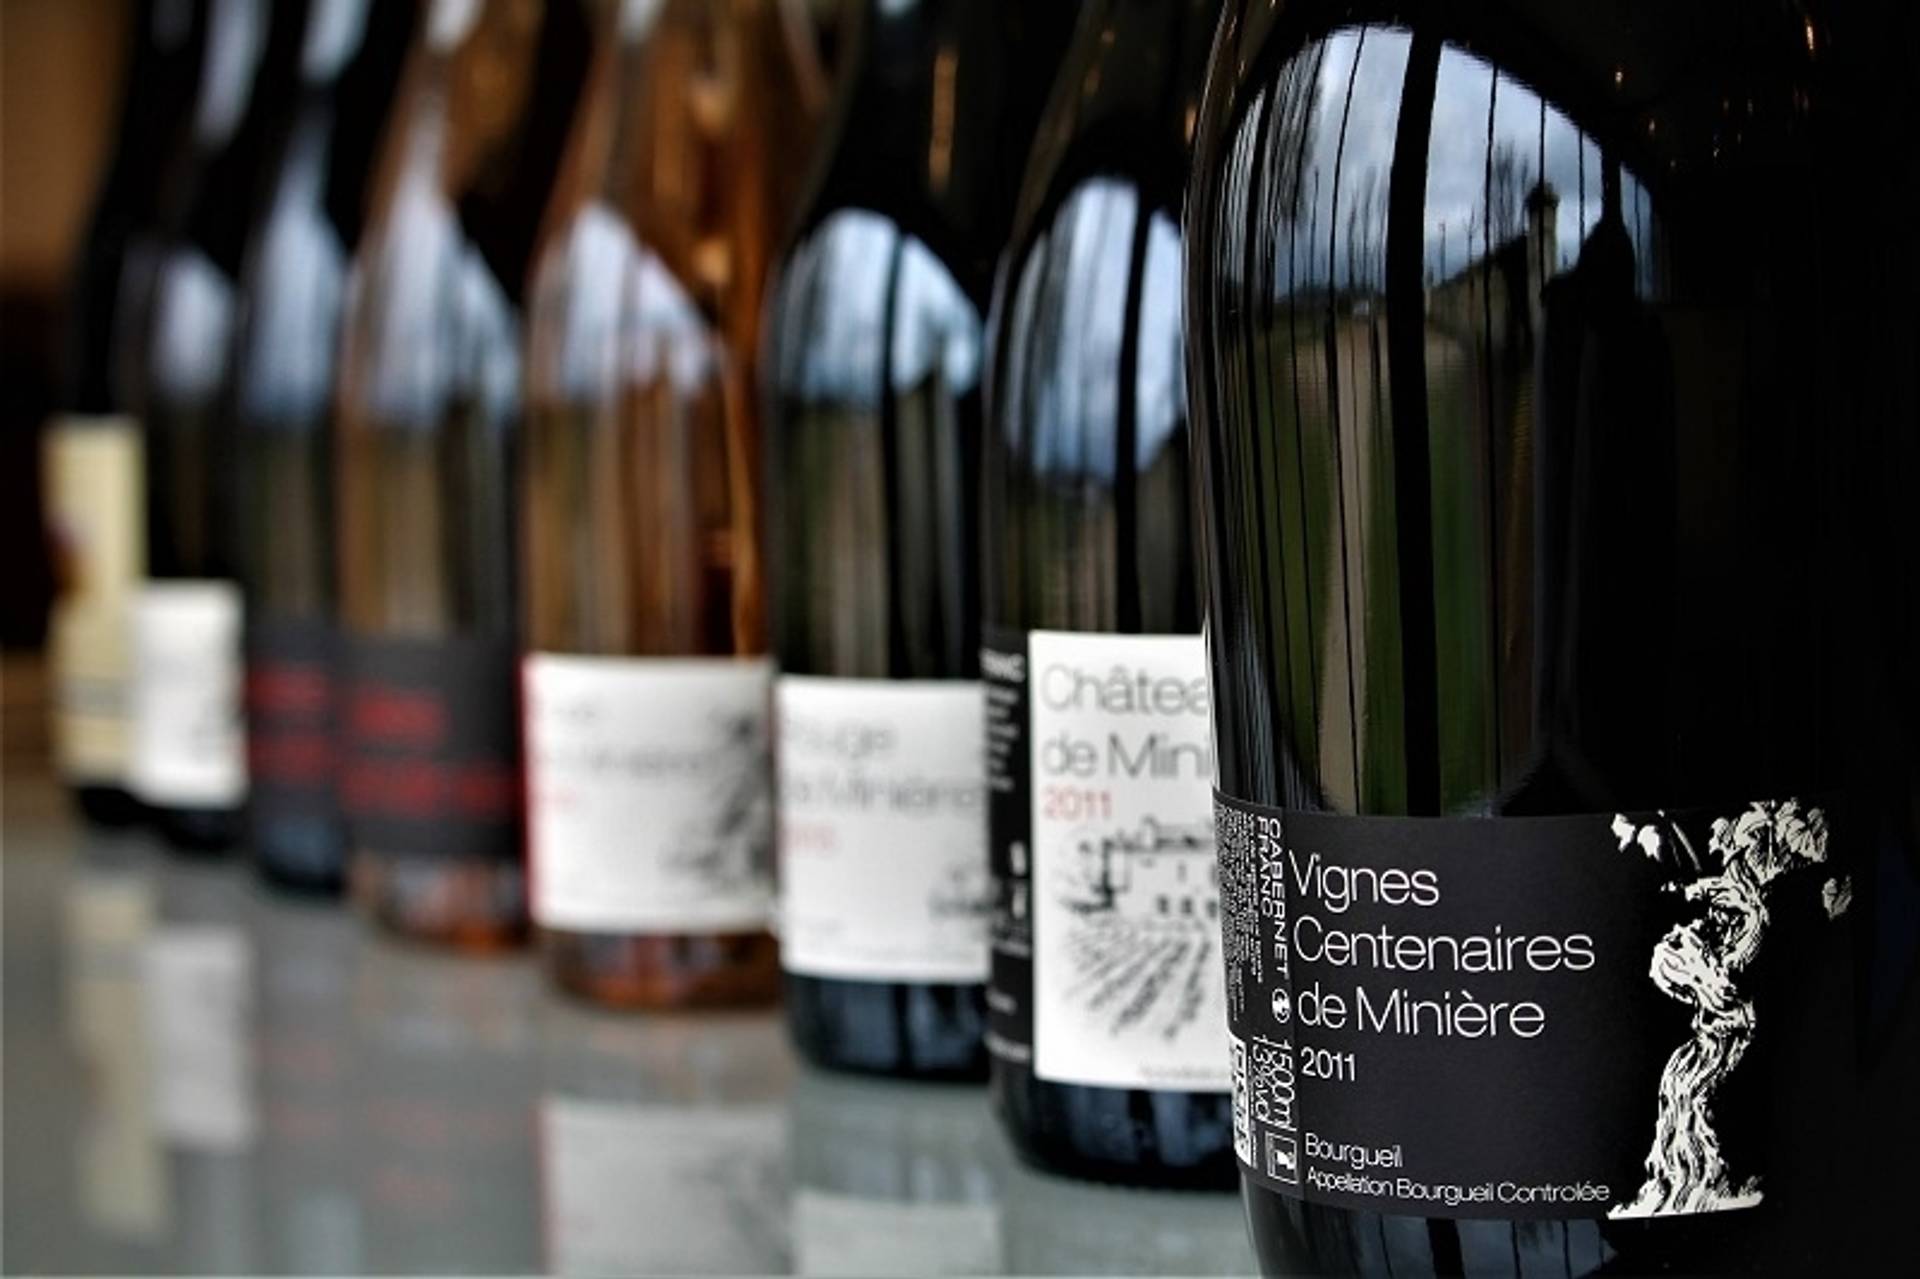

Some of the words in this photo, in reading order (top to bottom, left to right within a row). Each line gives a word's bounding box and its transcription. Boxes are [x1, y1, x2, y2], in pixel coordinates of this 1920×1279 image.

[1043, 730, 1098, 778] de
[1044, 785, 1112, 820] 2011
[1257, 816, 1272, 917] FRANC
[1288, 849, 1439, 913] Vignes
[1269, 818, 1290, 980] CABERNET
[1294, 915, 1596, 972] Centenaires
[1298, 982, 1346, 1029] de
[1356, 986, 1545, 1038] Minière
[1301, 1047, 1356, 1082] 2011
[1305, 1133, 1403, 1170] Bourgueil
[1306, 1166, 1393, 1197] Appellation
[1396, 1178, 1494, 1206] Bourgueil
[1497, 1180, 1610, 1202] Controlée
